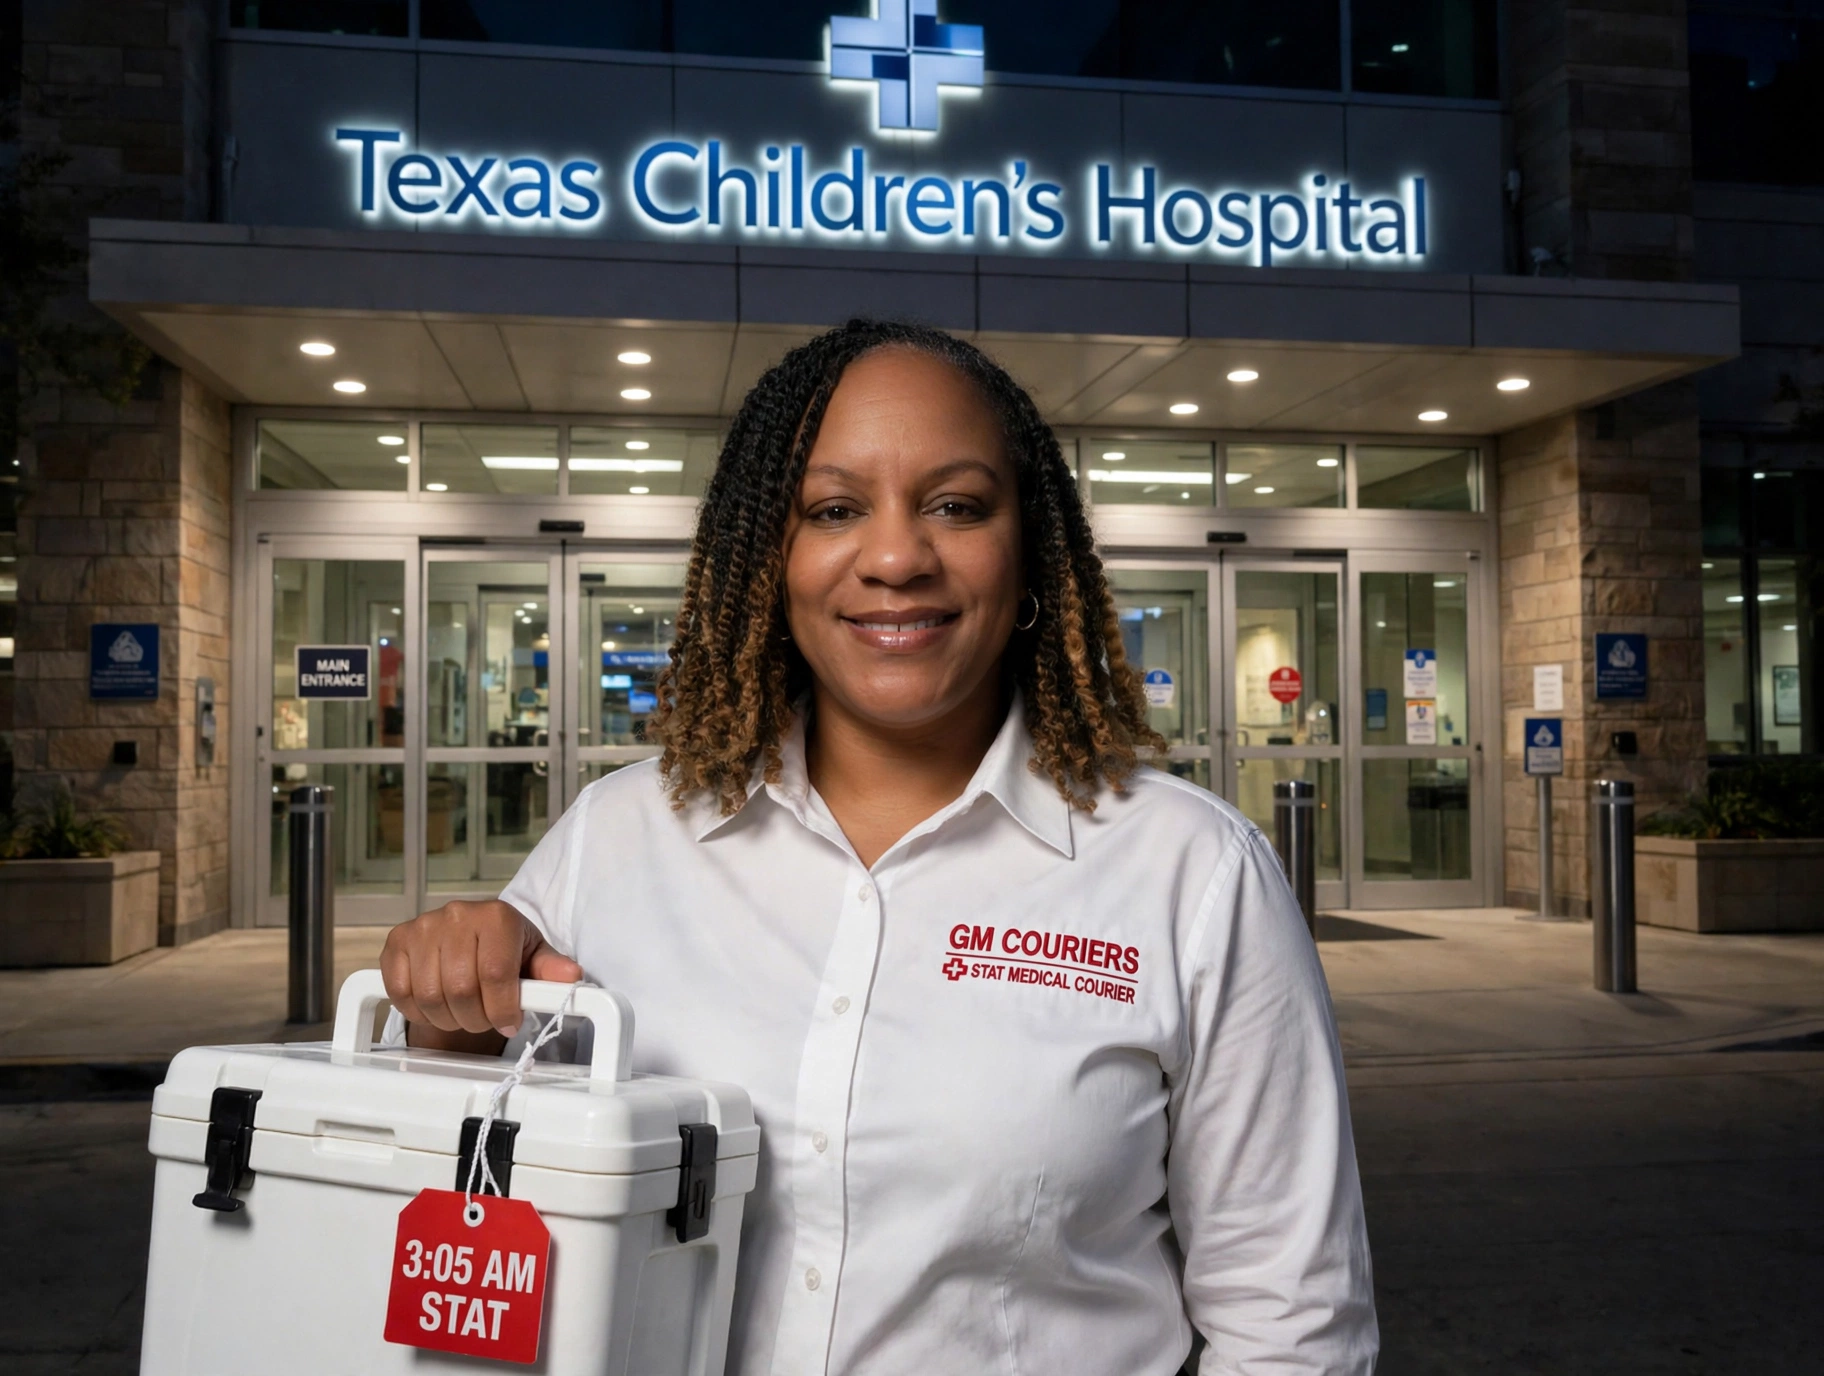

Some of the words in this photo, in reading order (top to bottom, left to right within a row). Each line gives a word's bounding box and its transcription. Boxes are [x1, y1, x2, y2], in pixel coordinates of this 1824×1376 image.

[335, 127, 601, 220] Texas
[633, 137, 1065, 240] Children's
[1097, 163, 1428, 267] Hospital
[301, 673, 366, 687] ENTRANCE
[316, 659, 350, 672] MAIN
[948, 923, 995, 952] GM
[1001, 928, 1140, 975] COURIERS
[970, 962, 1006, 981] STAT
[1007, 966, 1071, 990] MEDICAL
[1074, 976, 1136, 1005] COURIER
[402, 1239, 474, 1285] 3:05
[480, 1249, 537, 1295] AM
[419, 1291, 511, 1341] STAT
